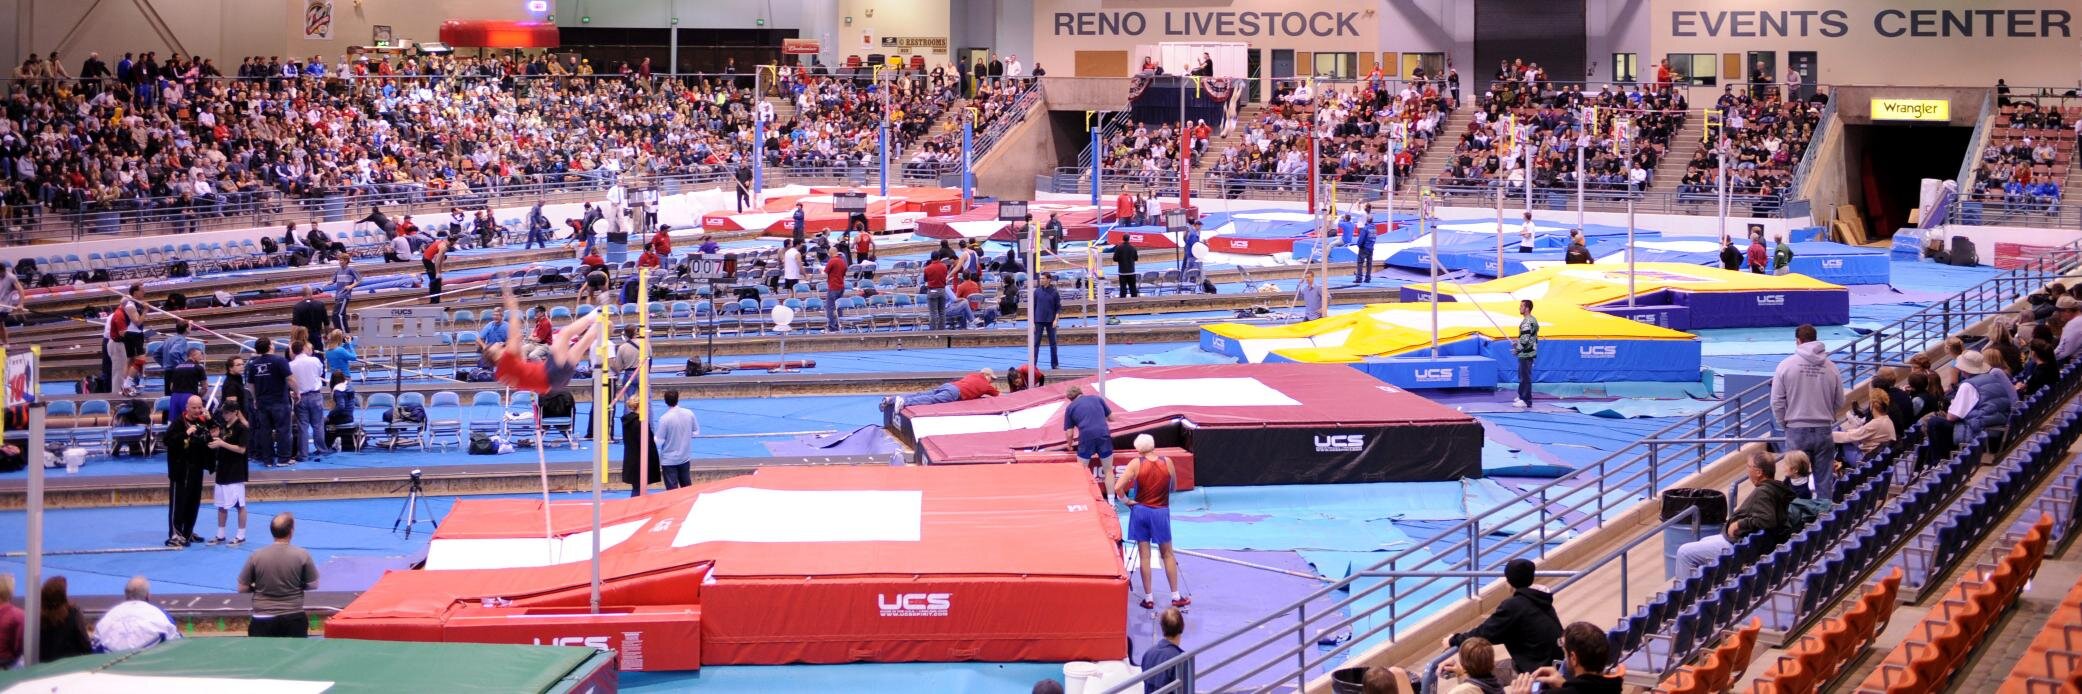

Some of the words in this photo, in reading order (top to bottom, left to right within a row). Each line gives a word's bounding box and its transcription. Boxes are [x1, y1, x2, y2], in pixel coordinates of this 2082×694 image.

[1054, 12, 1147, 35] RENO
[1164, 11, 1360, 36] LIVESTOCK
[1671, 10, 1849, 37] EVENTS
[1874, 9, 2072, 37] CENTER
[906, 38, 946, 46] RESTROOMS
[1884, 102, 1938, 118] Wrangler
[1822, 259, 1843, 267] UCS
[1757, 295, 1785, 303] UCS
[1580, 345, 1617, 355] UCS
[1415, 368, 1453, 378] UCS
[1314, 435, 1364, 447] UCS
[878, 593, 951, 610] UCS
